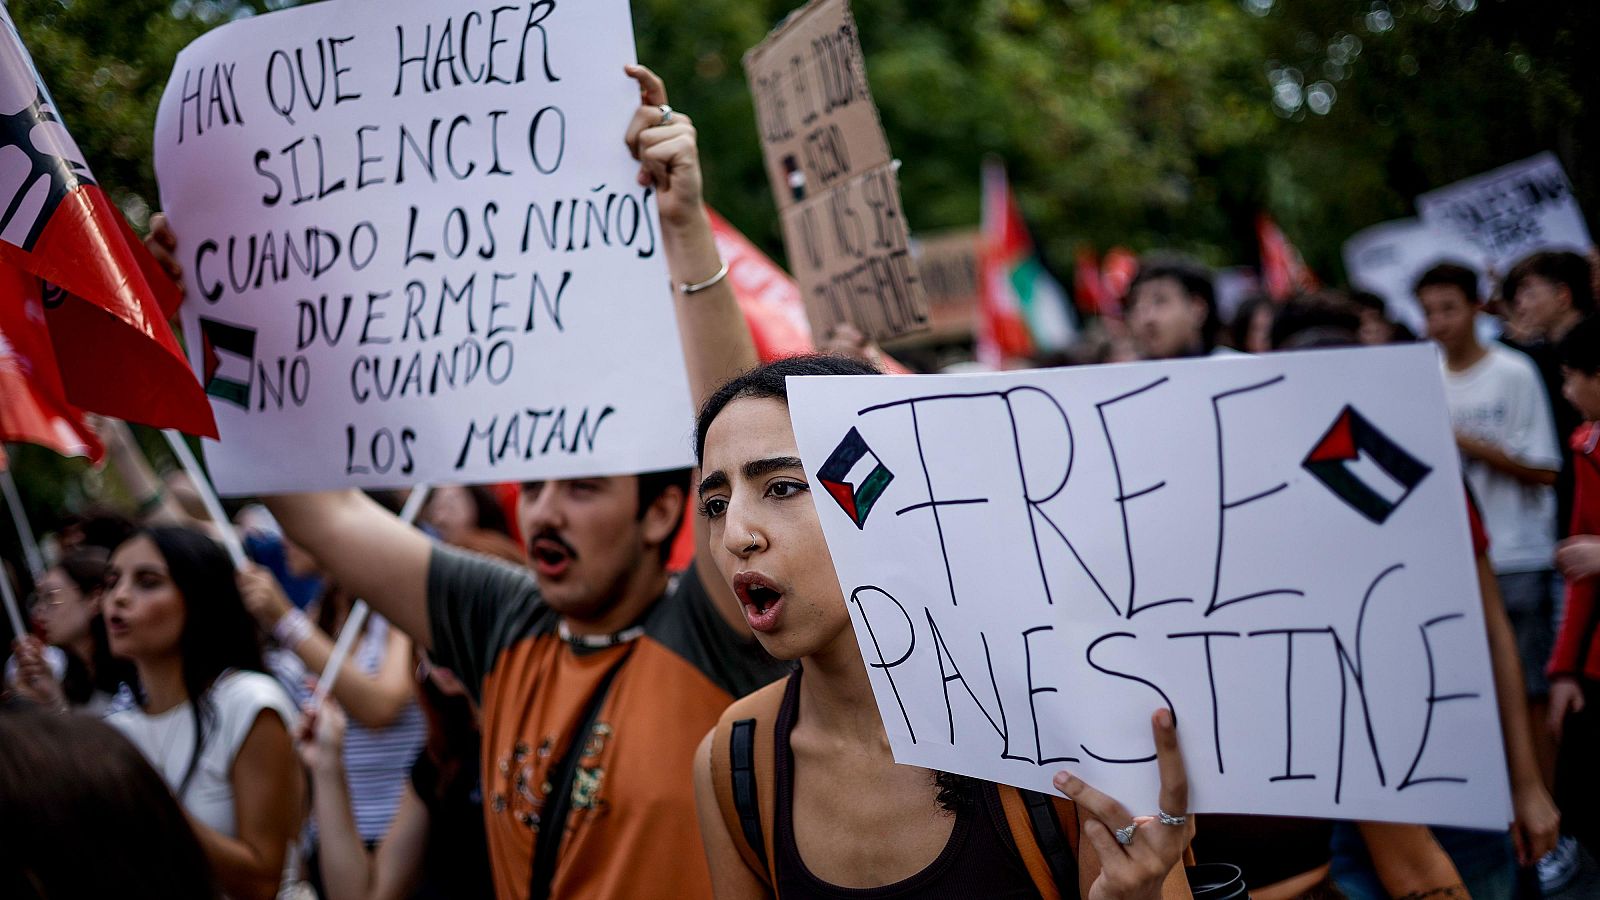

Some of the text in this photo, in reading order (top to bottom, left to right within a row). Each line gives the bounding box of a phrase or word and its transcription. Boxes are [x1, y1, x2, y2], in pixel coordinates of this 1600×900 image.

[178, 0, 560, 143] HAY QUE HACER
[254, 105, 566, 207] SILENCIO
[195, 184, 656, 304] CUANDO LOS NIÑOS
[297, 271, 573, 352] DUERMEN
[258, 340, 515, 412] NO CUANDO
[346, 405, 616, 475] LOS MATAN
[857, 375, 1305, 618] FREE
[850, 562, 1481, 804] PALESTINE
